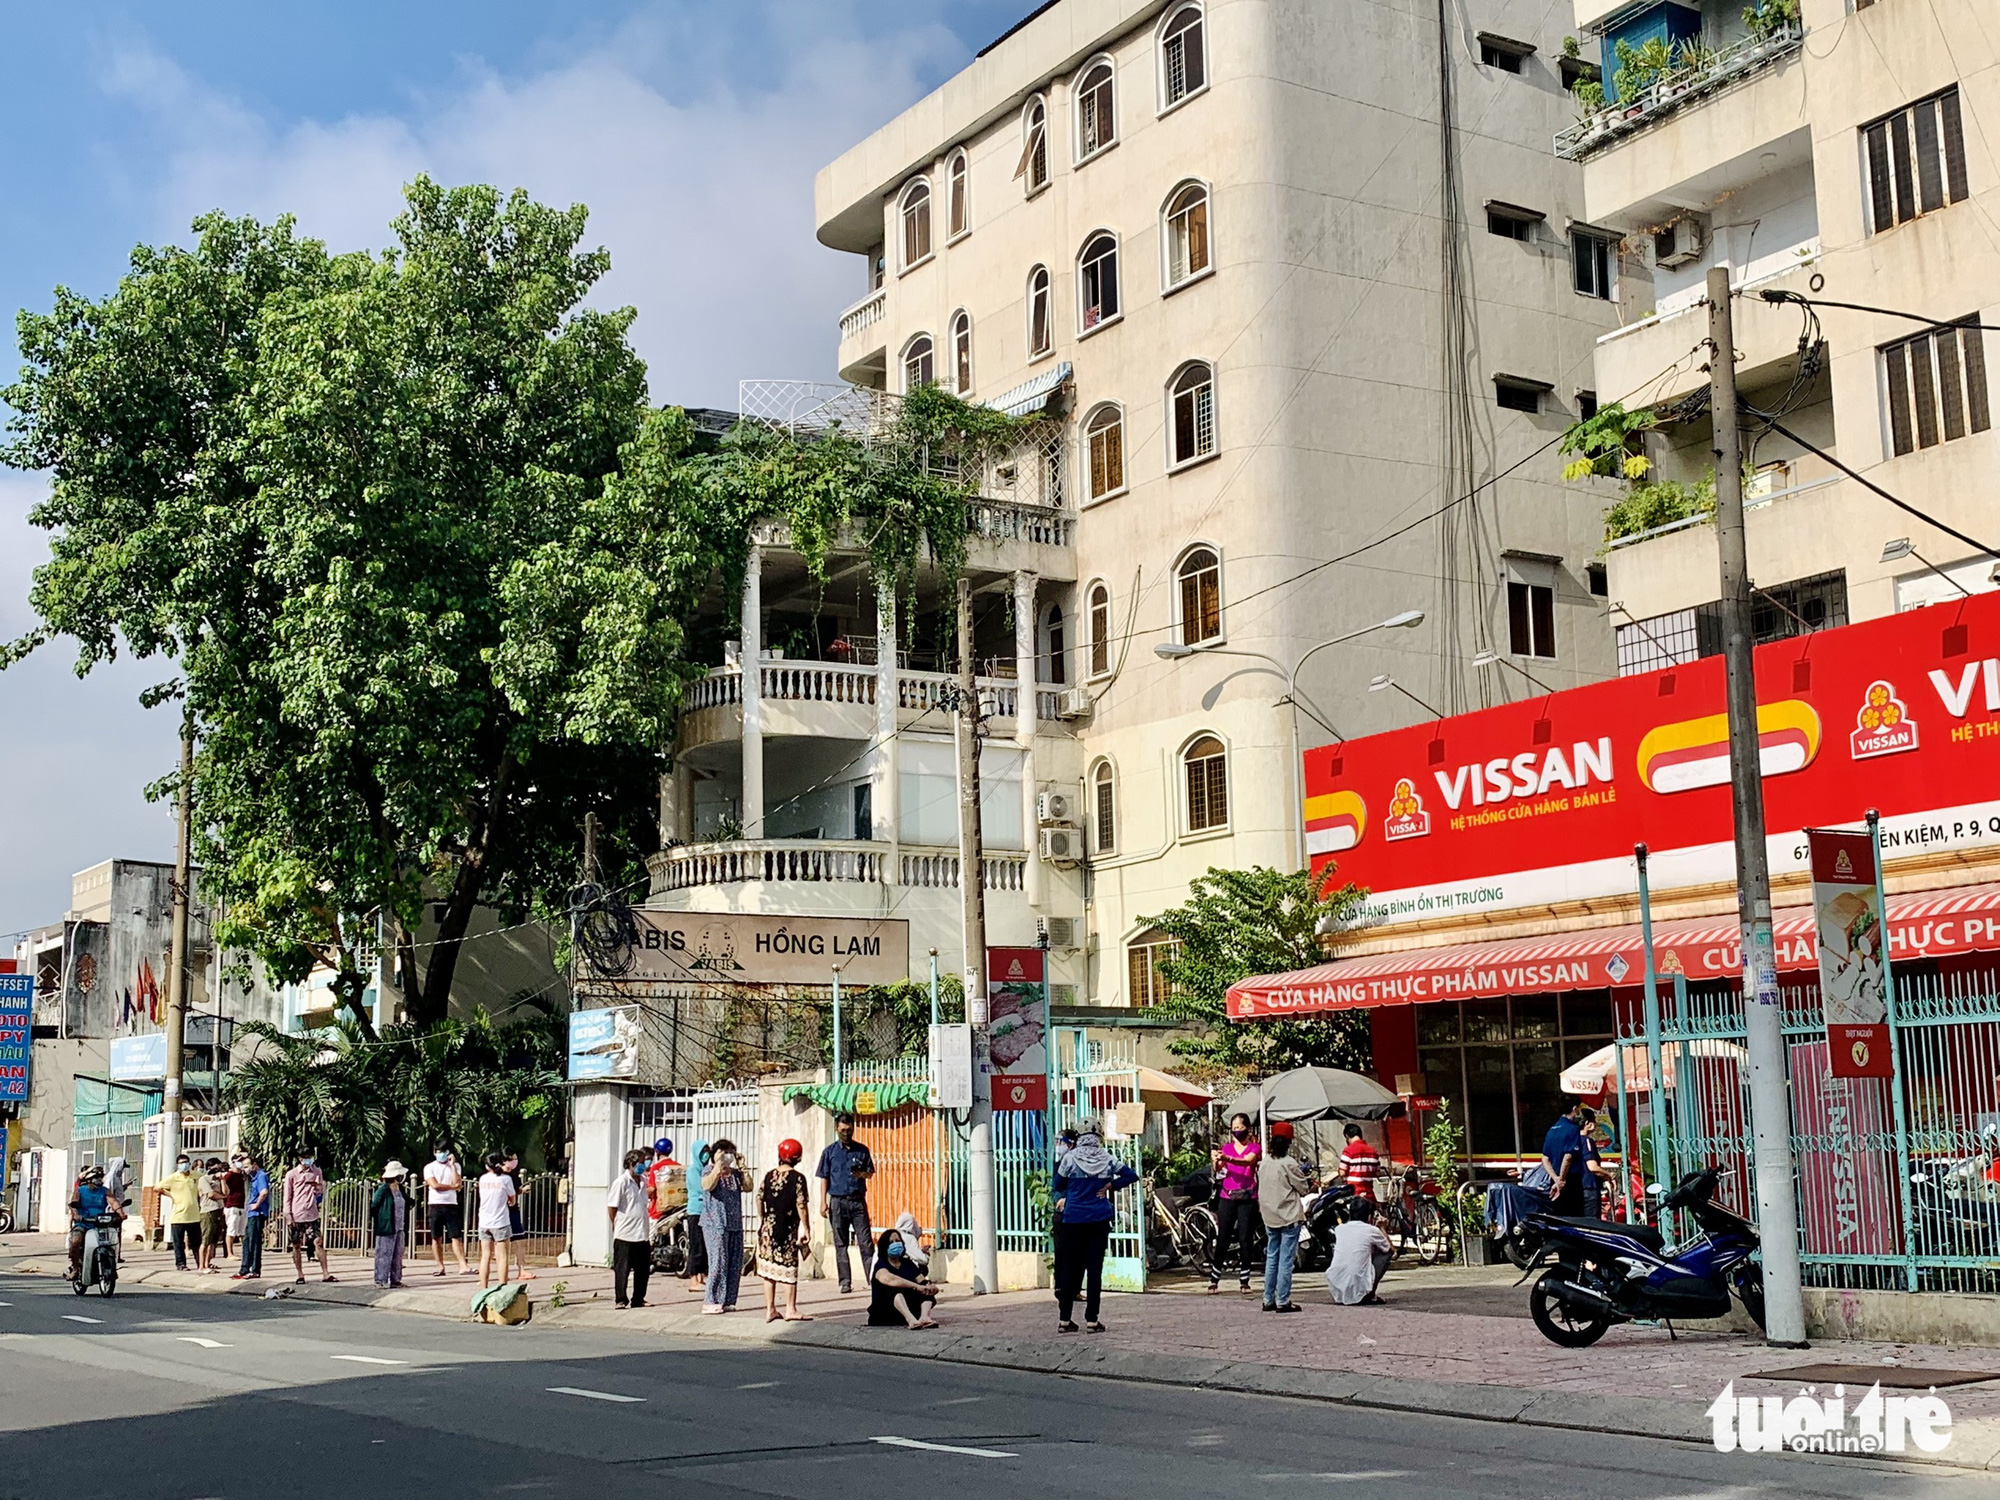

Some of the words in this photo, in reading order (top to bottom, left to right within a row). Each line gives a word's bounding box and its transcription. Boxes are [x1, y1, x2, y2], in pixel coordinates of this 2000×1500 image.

[1858, 732, 1909, 751] VISSAN
[1952, 723, 1973, 743] HỆ
[1976, 720, 2000, 738] TH
[1434, 737, 1613, 810] VISSAN
[1450, 814, 1466, 831] HỆ
[1466, 808, 1507, 828] THỐNG
[1508, 802, 1533, 820] CỬA
[1534, 799, 1569, 816] HÀNG
[1573, 791, 1600, 809] BÁN
[1601, 786, 1617, 804] LẺ
[1904, 823, 1948, 847] KIỆM,
[1953, 822, 1964, 838] P.
[1969, 820, 1983, 838] 9,
[1359, 902, 1389, 919] HÀNG
[1390, 899, 1416, 914] BÌNH
[1418, 893, 1434, 911] ỔN
[1436, 895, 1454, 910] THỊ
[1455, 887, 1504, 906] TRƯỜNG
[756, 926, 825, 955] HỒNG
[834, 935, 880, 956] LAM
[1703, 942, 1741, 970] CỬ
[1887, 921, 1955, 954] HỰC
[1266, 984, 1305, 1009] CỬA
[1309, 980, 1366, 1005] HÀNG
[1370, 975, 1426, 1002] THỰC
[1433, 966, 1498, 993] PHẨM
[1502, 961, 1589, 988] VISSAN
